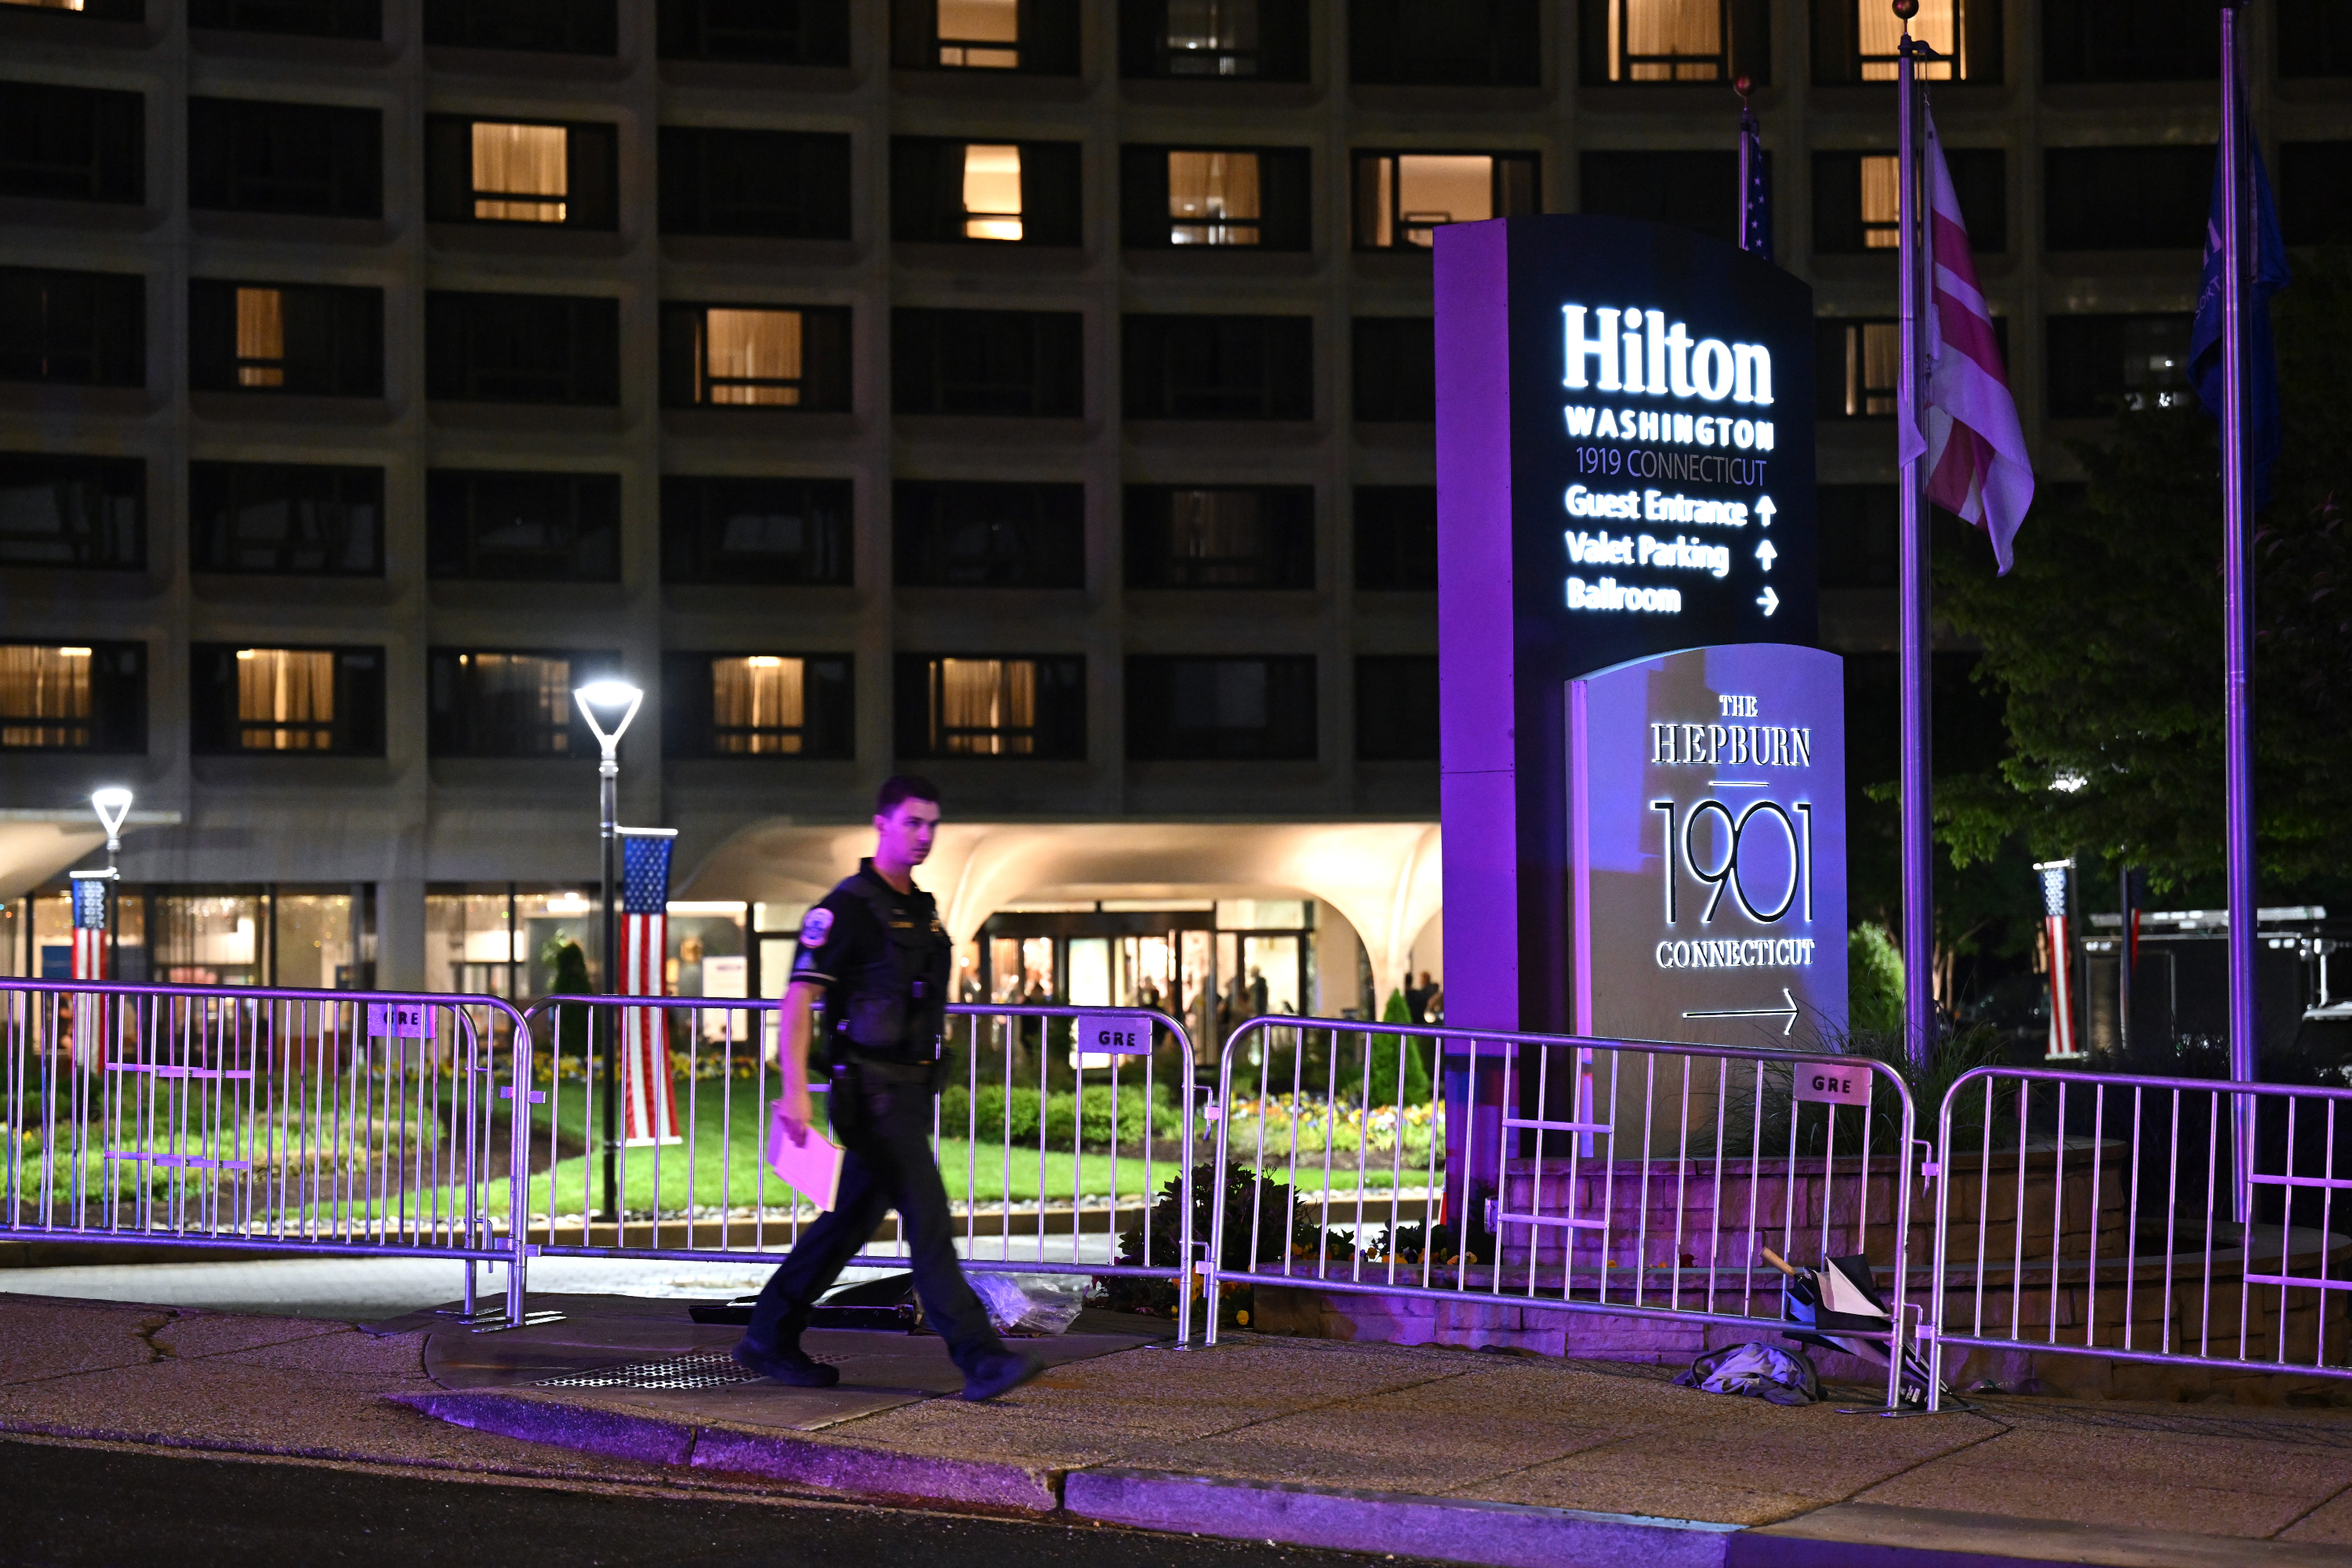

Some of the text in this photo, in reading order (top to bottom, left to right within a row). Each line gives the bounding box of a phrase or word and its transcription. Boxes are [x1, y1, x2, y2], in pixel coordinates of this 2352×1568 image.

[1563, 304, 1774, 405] Hilton
[1564, 405, 1774, 451] WASHINGTON
[1576, 447, 1767, 487] 1919 CONNECTICUT
[1565, 485, 1748, 526] Guest Entrance
[1565, 531, 1730, 578] Valet Parking
[1566, 577, 1682, 612] Ballroom
[1719, 695, 1759, 717] THE
[1650, 723, 1811, 767] HEPBURN
[1650, 799, 1812, 924] 1901
[1656, 938, 1815, 969] CONNECTICUT
[383, 1011, 419, 1025] GRE
[1098, 1030, 1135, 1047] GRE
[1812, 1076, 1851, 1093] GRE
